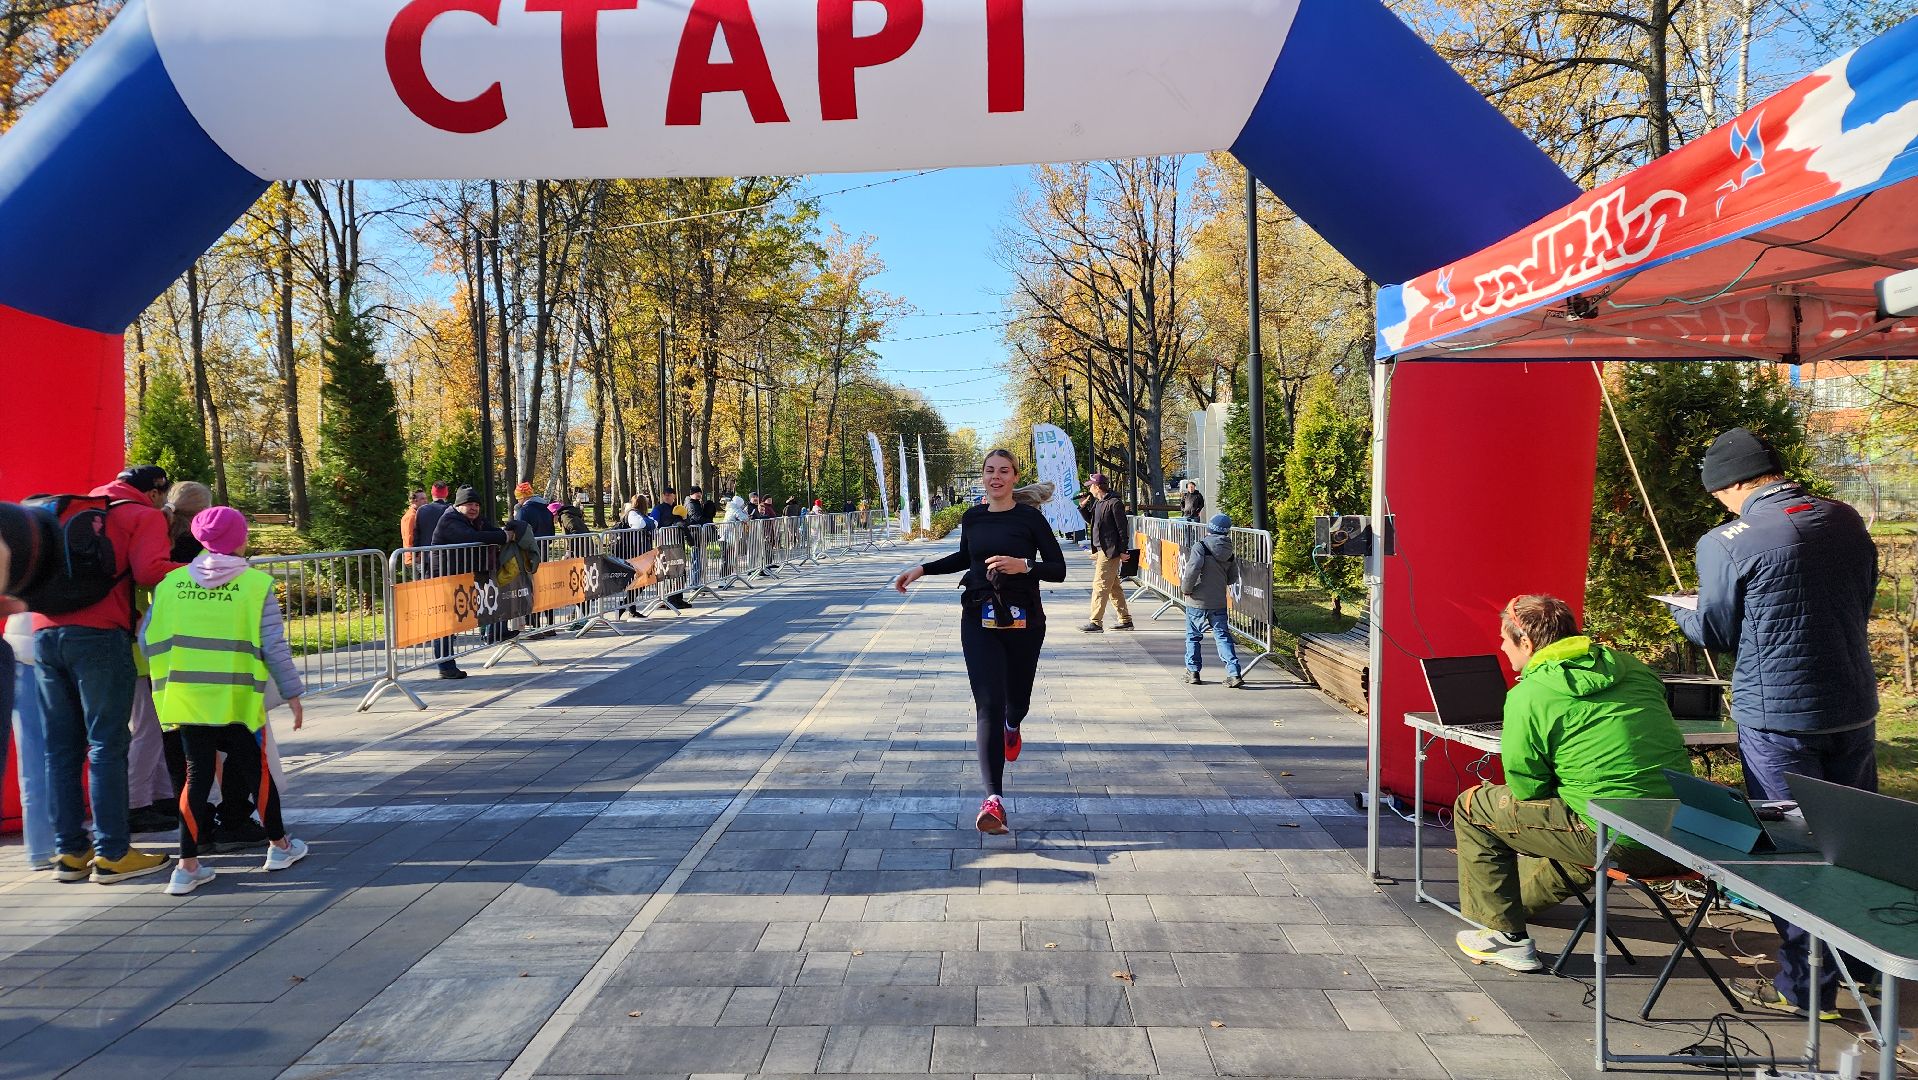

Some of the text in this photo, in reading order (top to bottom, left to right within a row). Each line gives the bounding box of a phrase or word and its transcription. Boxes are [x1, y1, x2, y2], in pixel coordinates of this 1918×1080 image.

[1547, 310, 1564, 318] OPEN
[176, 581, 240, 592] ФАБКА
[177, 590, 233, 602] СПОРТА
